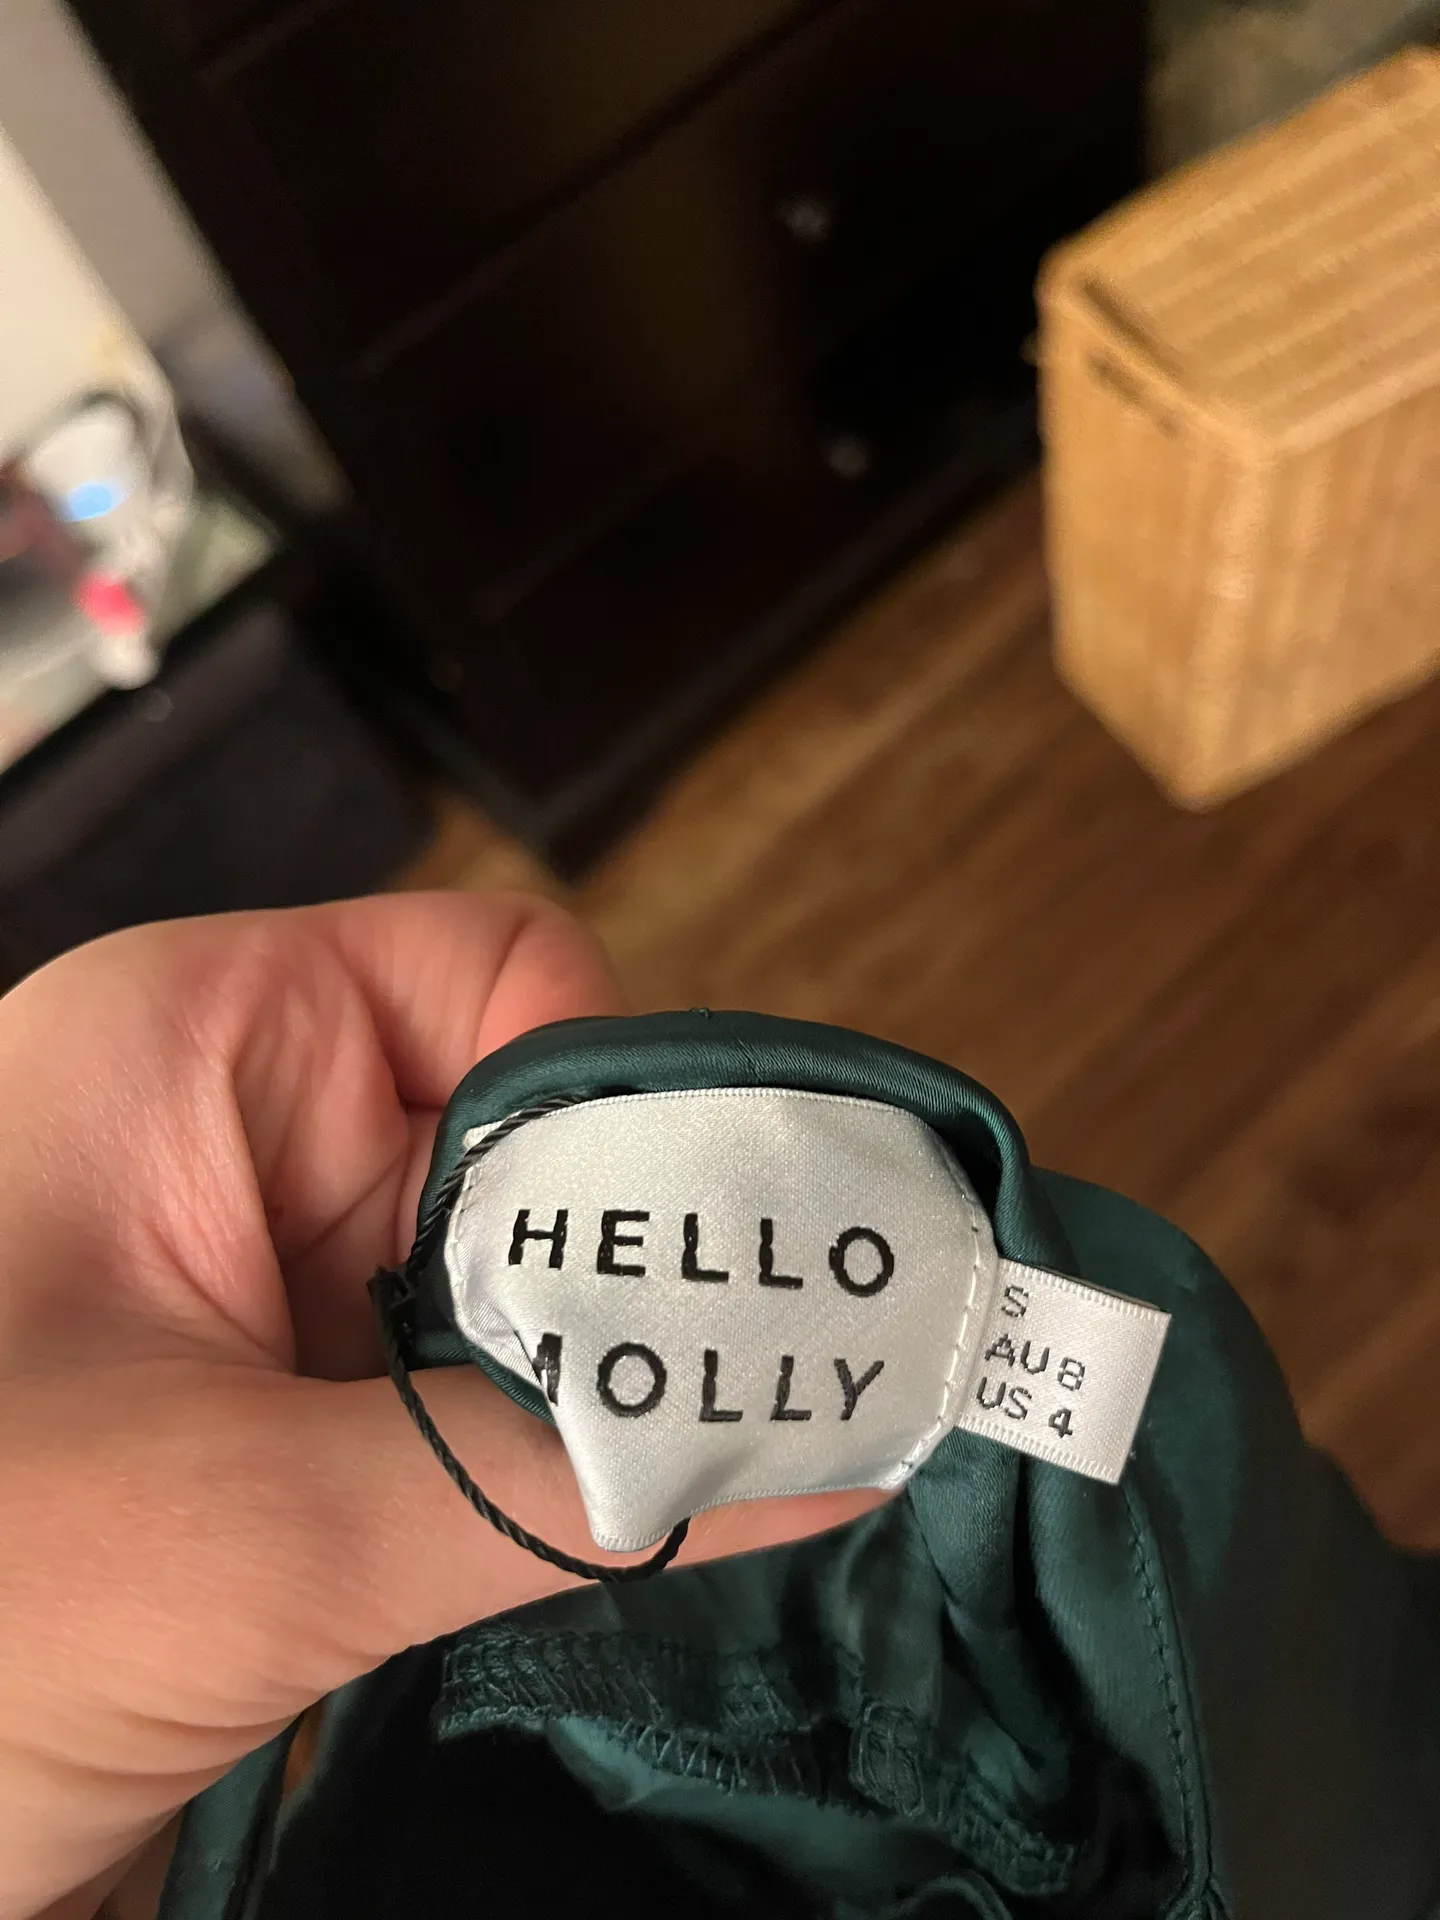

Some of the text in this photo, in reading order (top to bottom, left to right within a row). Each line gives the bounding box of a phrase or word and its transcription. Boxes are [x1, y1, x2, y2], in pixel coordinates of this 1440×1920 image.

[507, 1208, 895, 1298] HELLO
[1001, 1283, 1029, 1318] S
[984, 1333, 1086, 1392] AU 8
[976, 1376, 1073, 1439] US 4
